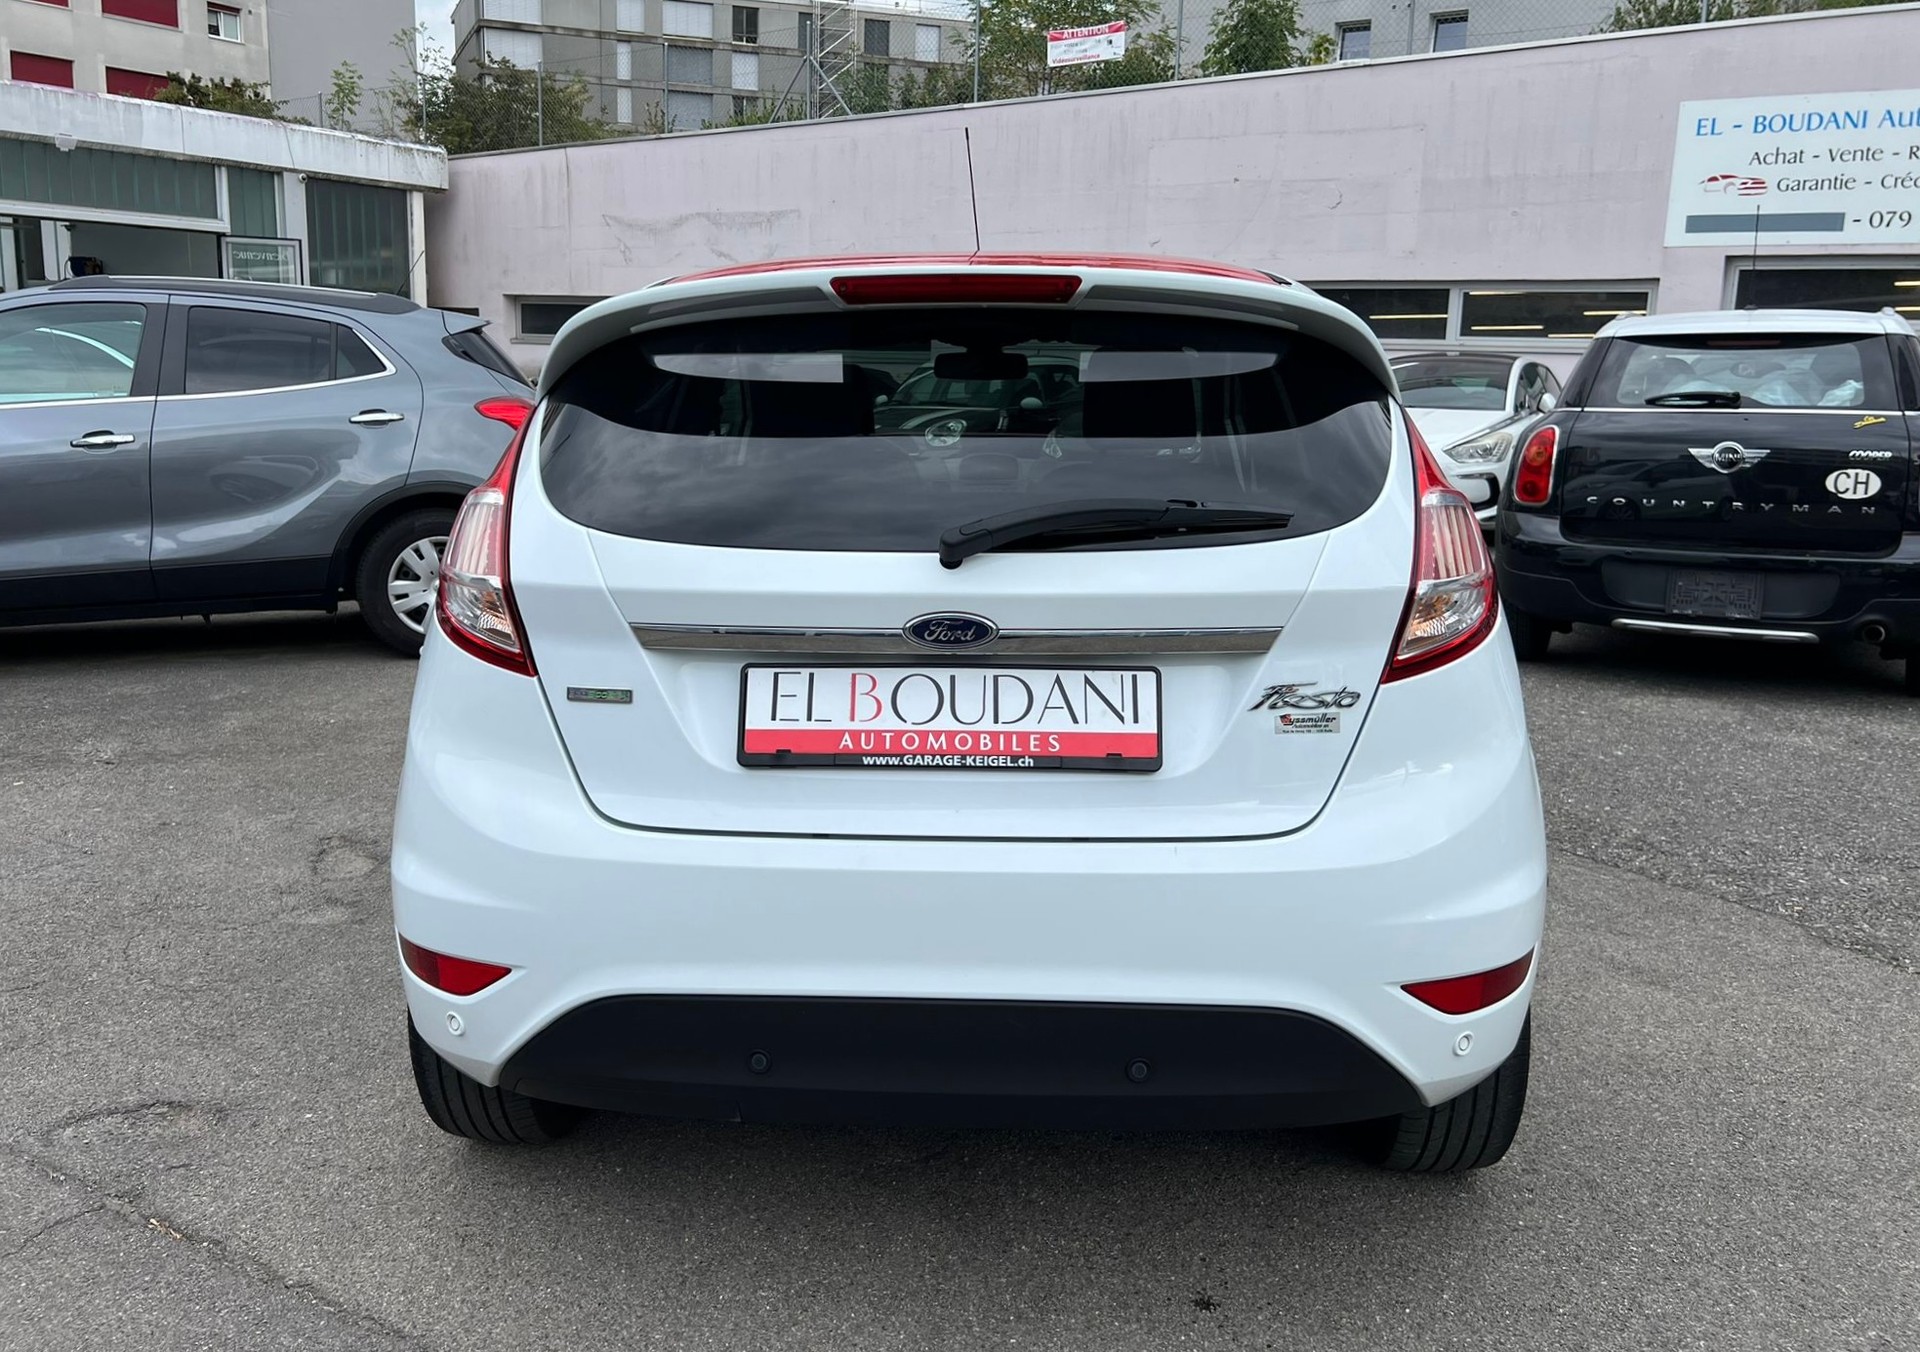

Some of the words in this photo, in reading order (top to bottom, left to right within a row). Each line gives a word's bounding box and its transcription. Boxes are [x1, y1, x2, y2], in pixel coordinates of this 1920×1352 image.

[1063, 25, 1109, 39] ATTENTION
[1695, 117, 1724, 136] EL
[1752, 110, 1869, 134] BOUDANI
[1749, 147, 1805, 166] Achat
[1828, 145, 1884, 163] Vente
[1776, 173, 1857, 192] Garantie
[1869, 210, 1912, 229] 079
[1715, 453, 1741, 462] MINI
[1848, 450, 1893, 461] COOPER
[1833, 471, 1870, 495] CH
[1586, 495, 1875, 515] COUNTRYMAN
[924, 620, 976, 641] Ford
[770, 671, 832, 723] EL
[848, 671, 1139, 726] BOUDANI
[1247, 681, 1361, 712] Fiesta
[838, 731, 1061, 752] AUTOMOBILES
[862, 754, 1035, 768] www.GARAGE-KEIGEL.ch
